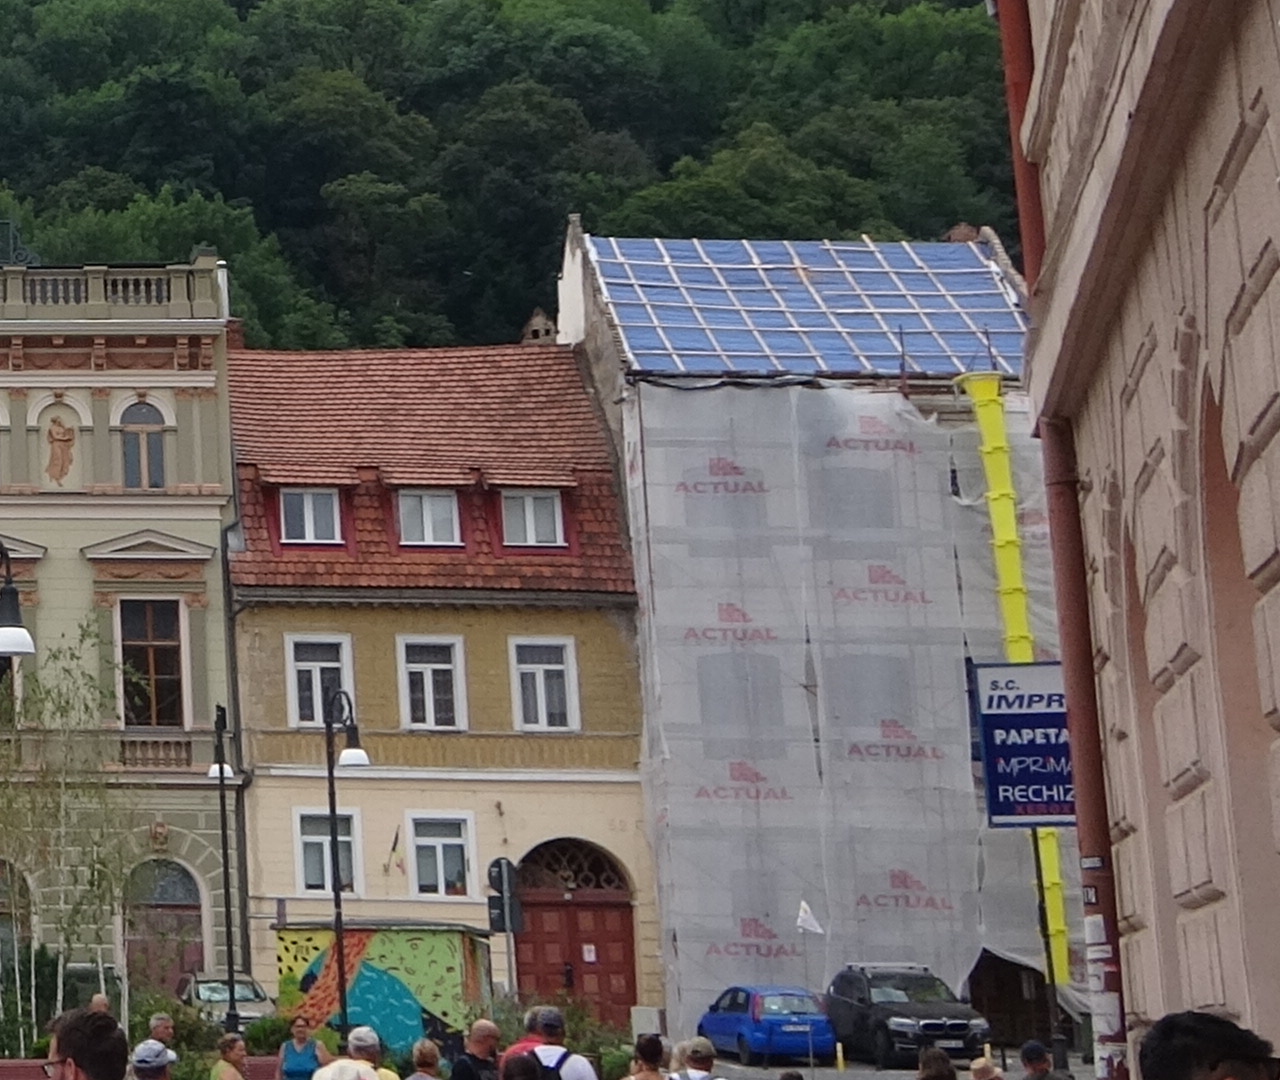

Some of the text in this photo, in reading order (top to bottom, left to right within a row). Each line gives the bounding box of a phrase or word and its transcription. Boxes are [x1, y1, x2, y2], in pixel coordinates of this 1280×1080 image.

[826, 435, 921, 455] ACTUAL
[674, 480, 770, 494] ACTUAL
[834, 588, 933, 604] ACTUAL
[683, 627, 778, 641] ACTUAL
[990, 679, 1020, 691] S.C.
[987, 693, 1065, 710] IMPR
[848, 744, 944, 760] ACTUAL
[695, 786, 794, 801] ACTUAL
[1014, 802, 1072, 815] XEROX
[856, 893, 953, 910] ACTUAL
[706, 942, 803, 958] ACTUAL
